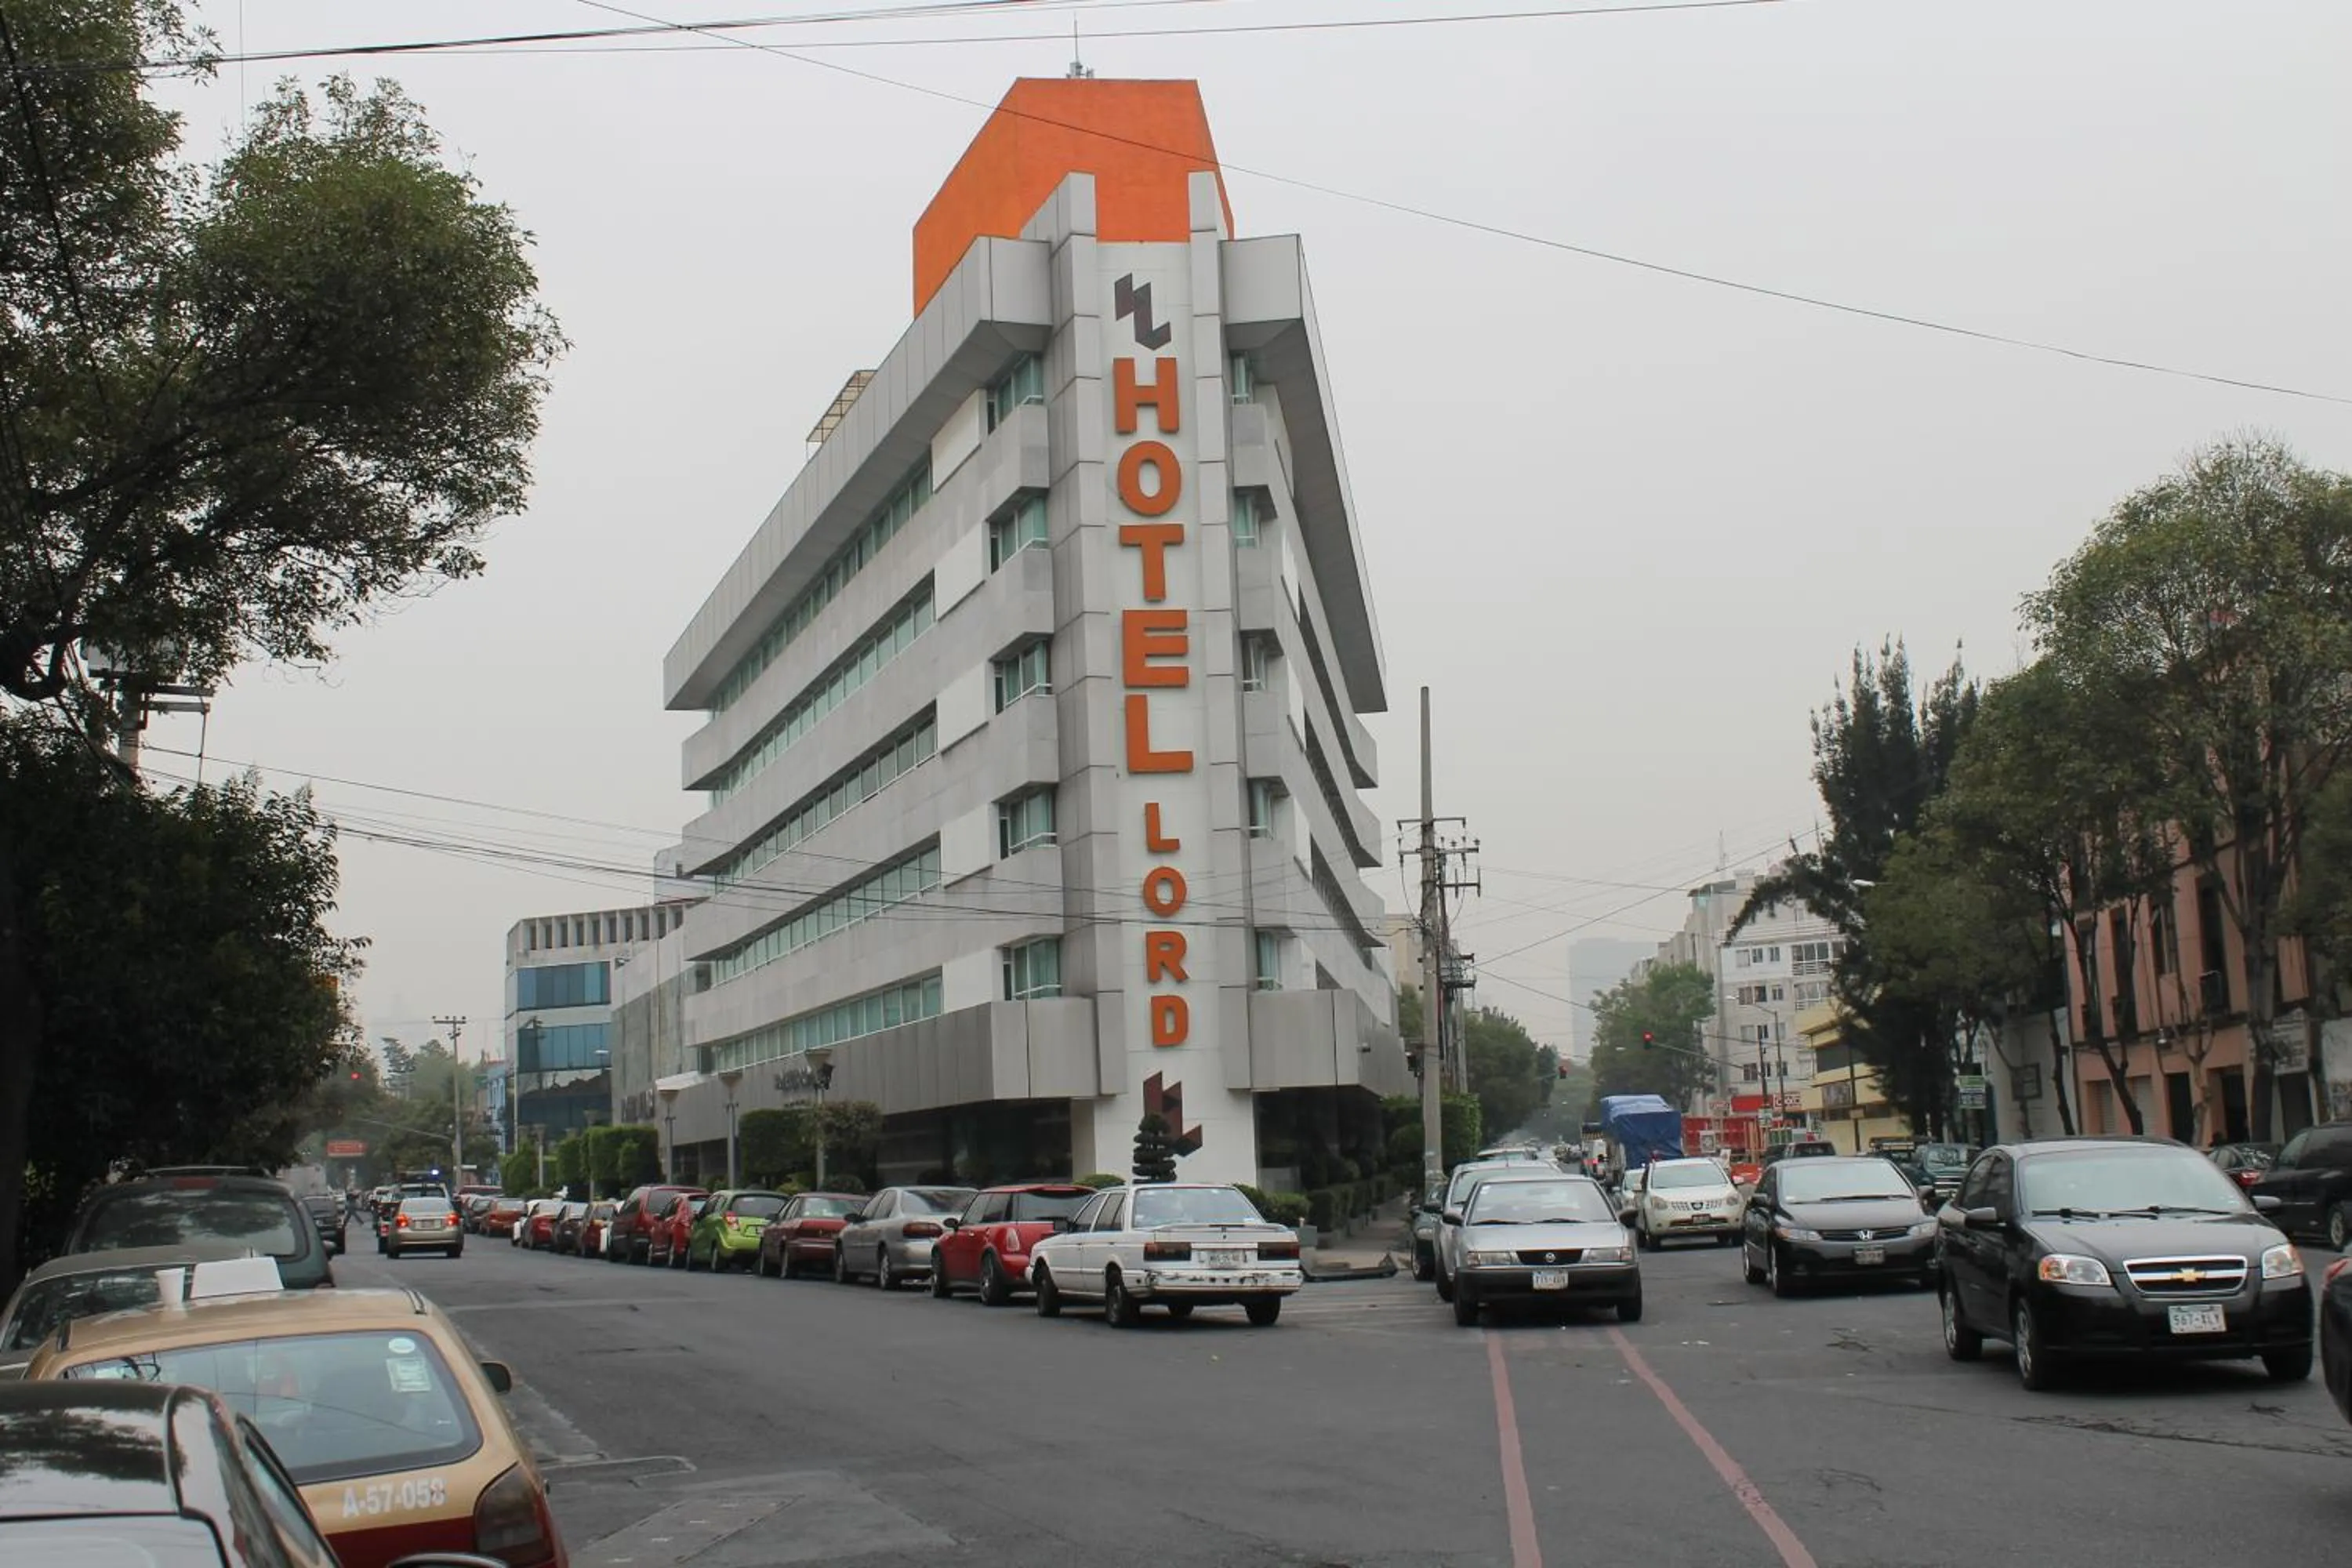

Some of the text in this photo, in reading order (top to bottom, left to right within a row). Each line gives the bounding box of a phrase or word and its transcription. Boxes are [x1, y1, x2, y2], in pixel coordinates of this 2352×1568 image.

[1113, 357, 1192, 1047] HOTEL LORD
[342, 1477, 446, 1519] A-57-058
